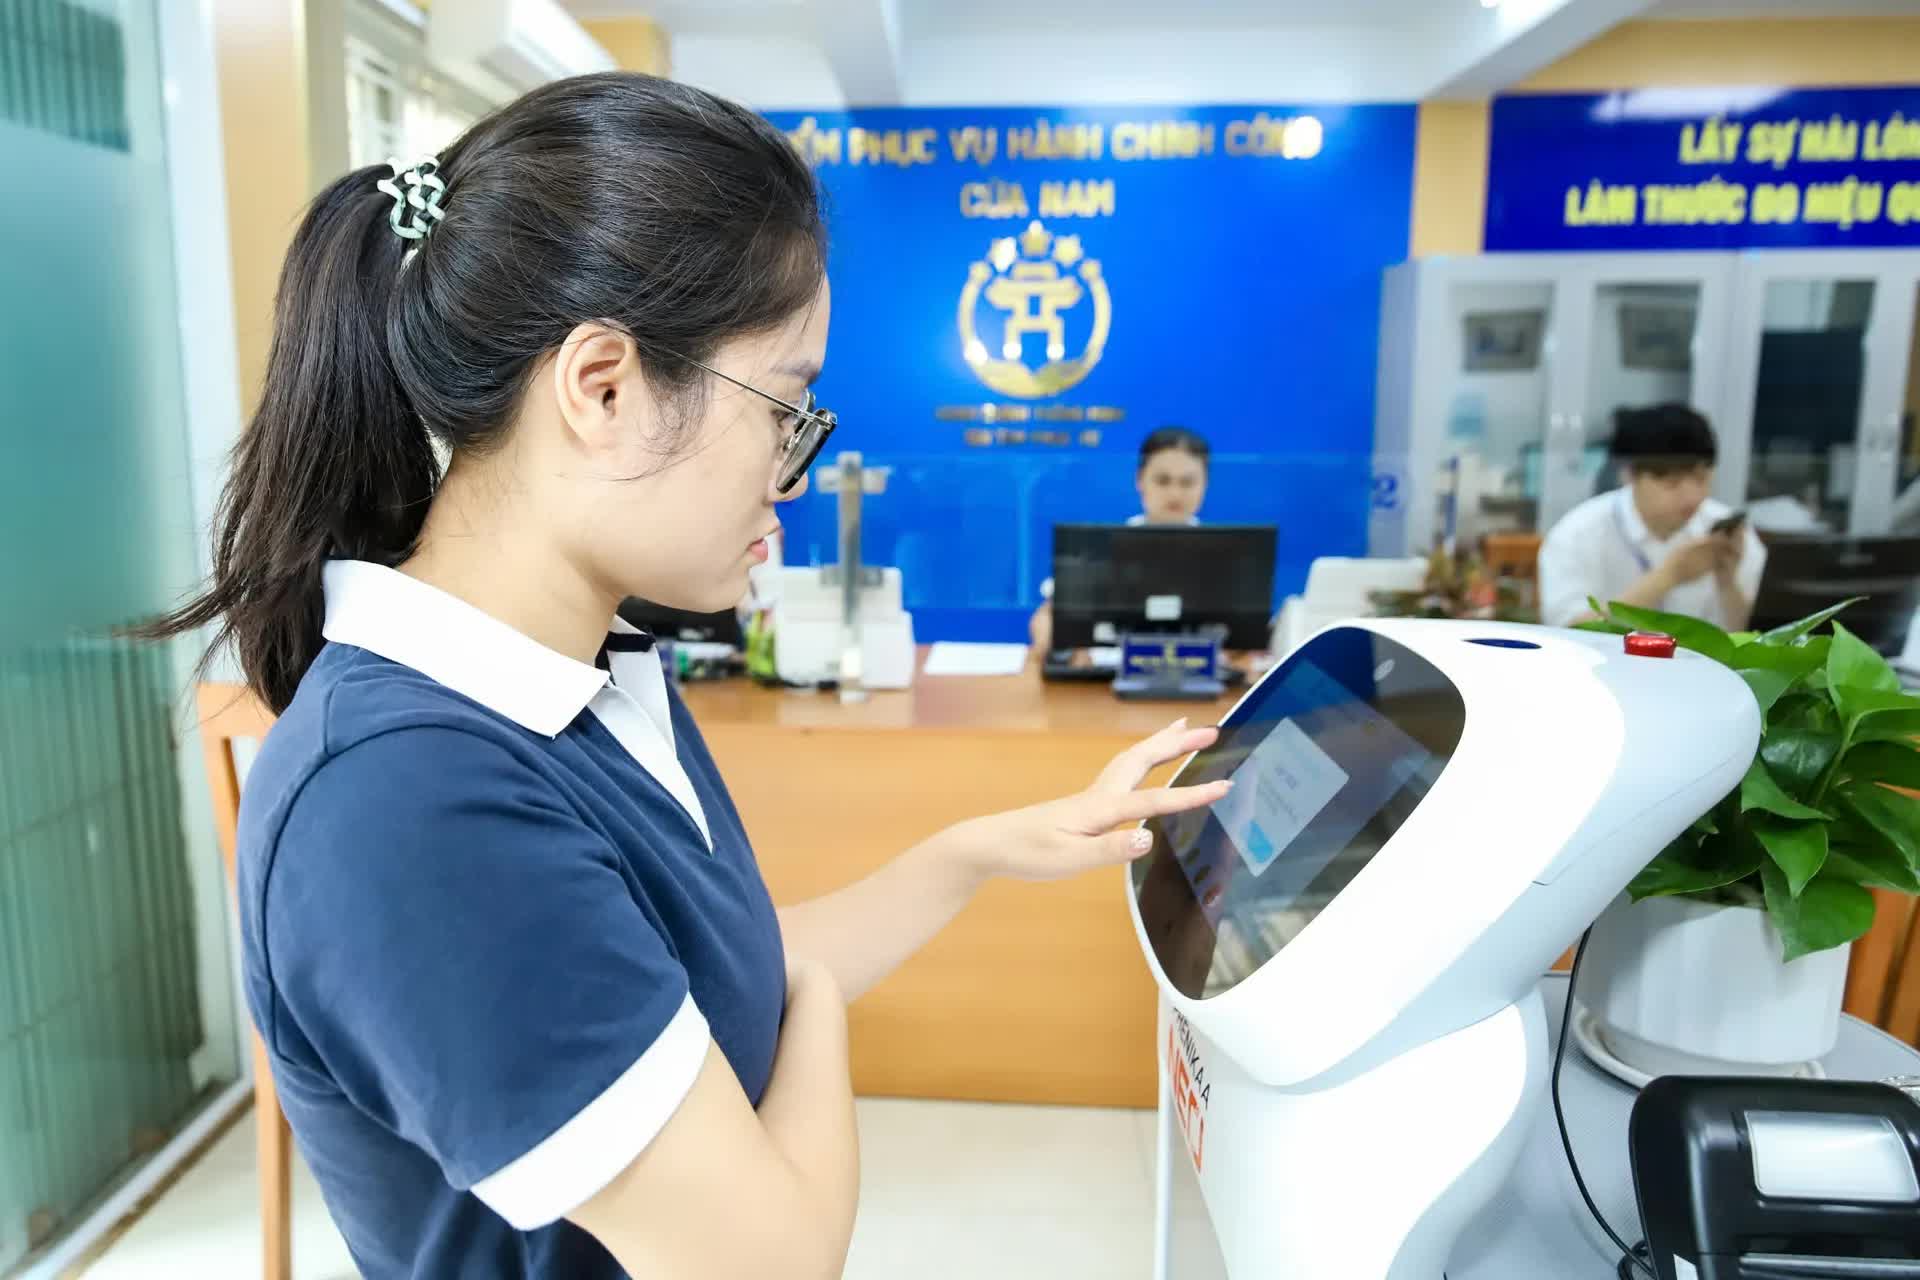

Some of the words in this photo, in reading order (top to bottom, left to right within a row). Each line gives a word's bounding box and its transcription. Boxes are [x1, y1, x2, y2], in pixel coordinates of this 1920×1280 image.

[847, 126, 937, 168] PHỤC
[950, 124, 998, 167] VỤ
[1007, 116, 1104, 161] HÀNH
[1038, 179, 1116, 218] NAM
[1563, 178, 1639, 226] LÀM
